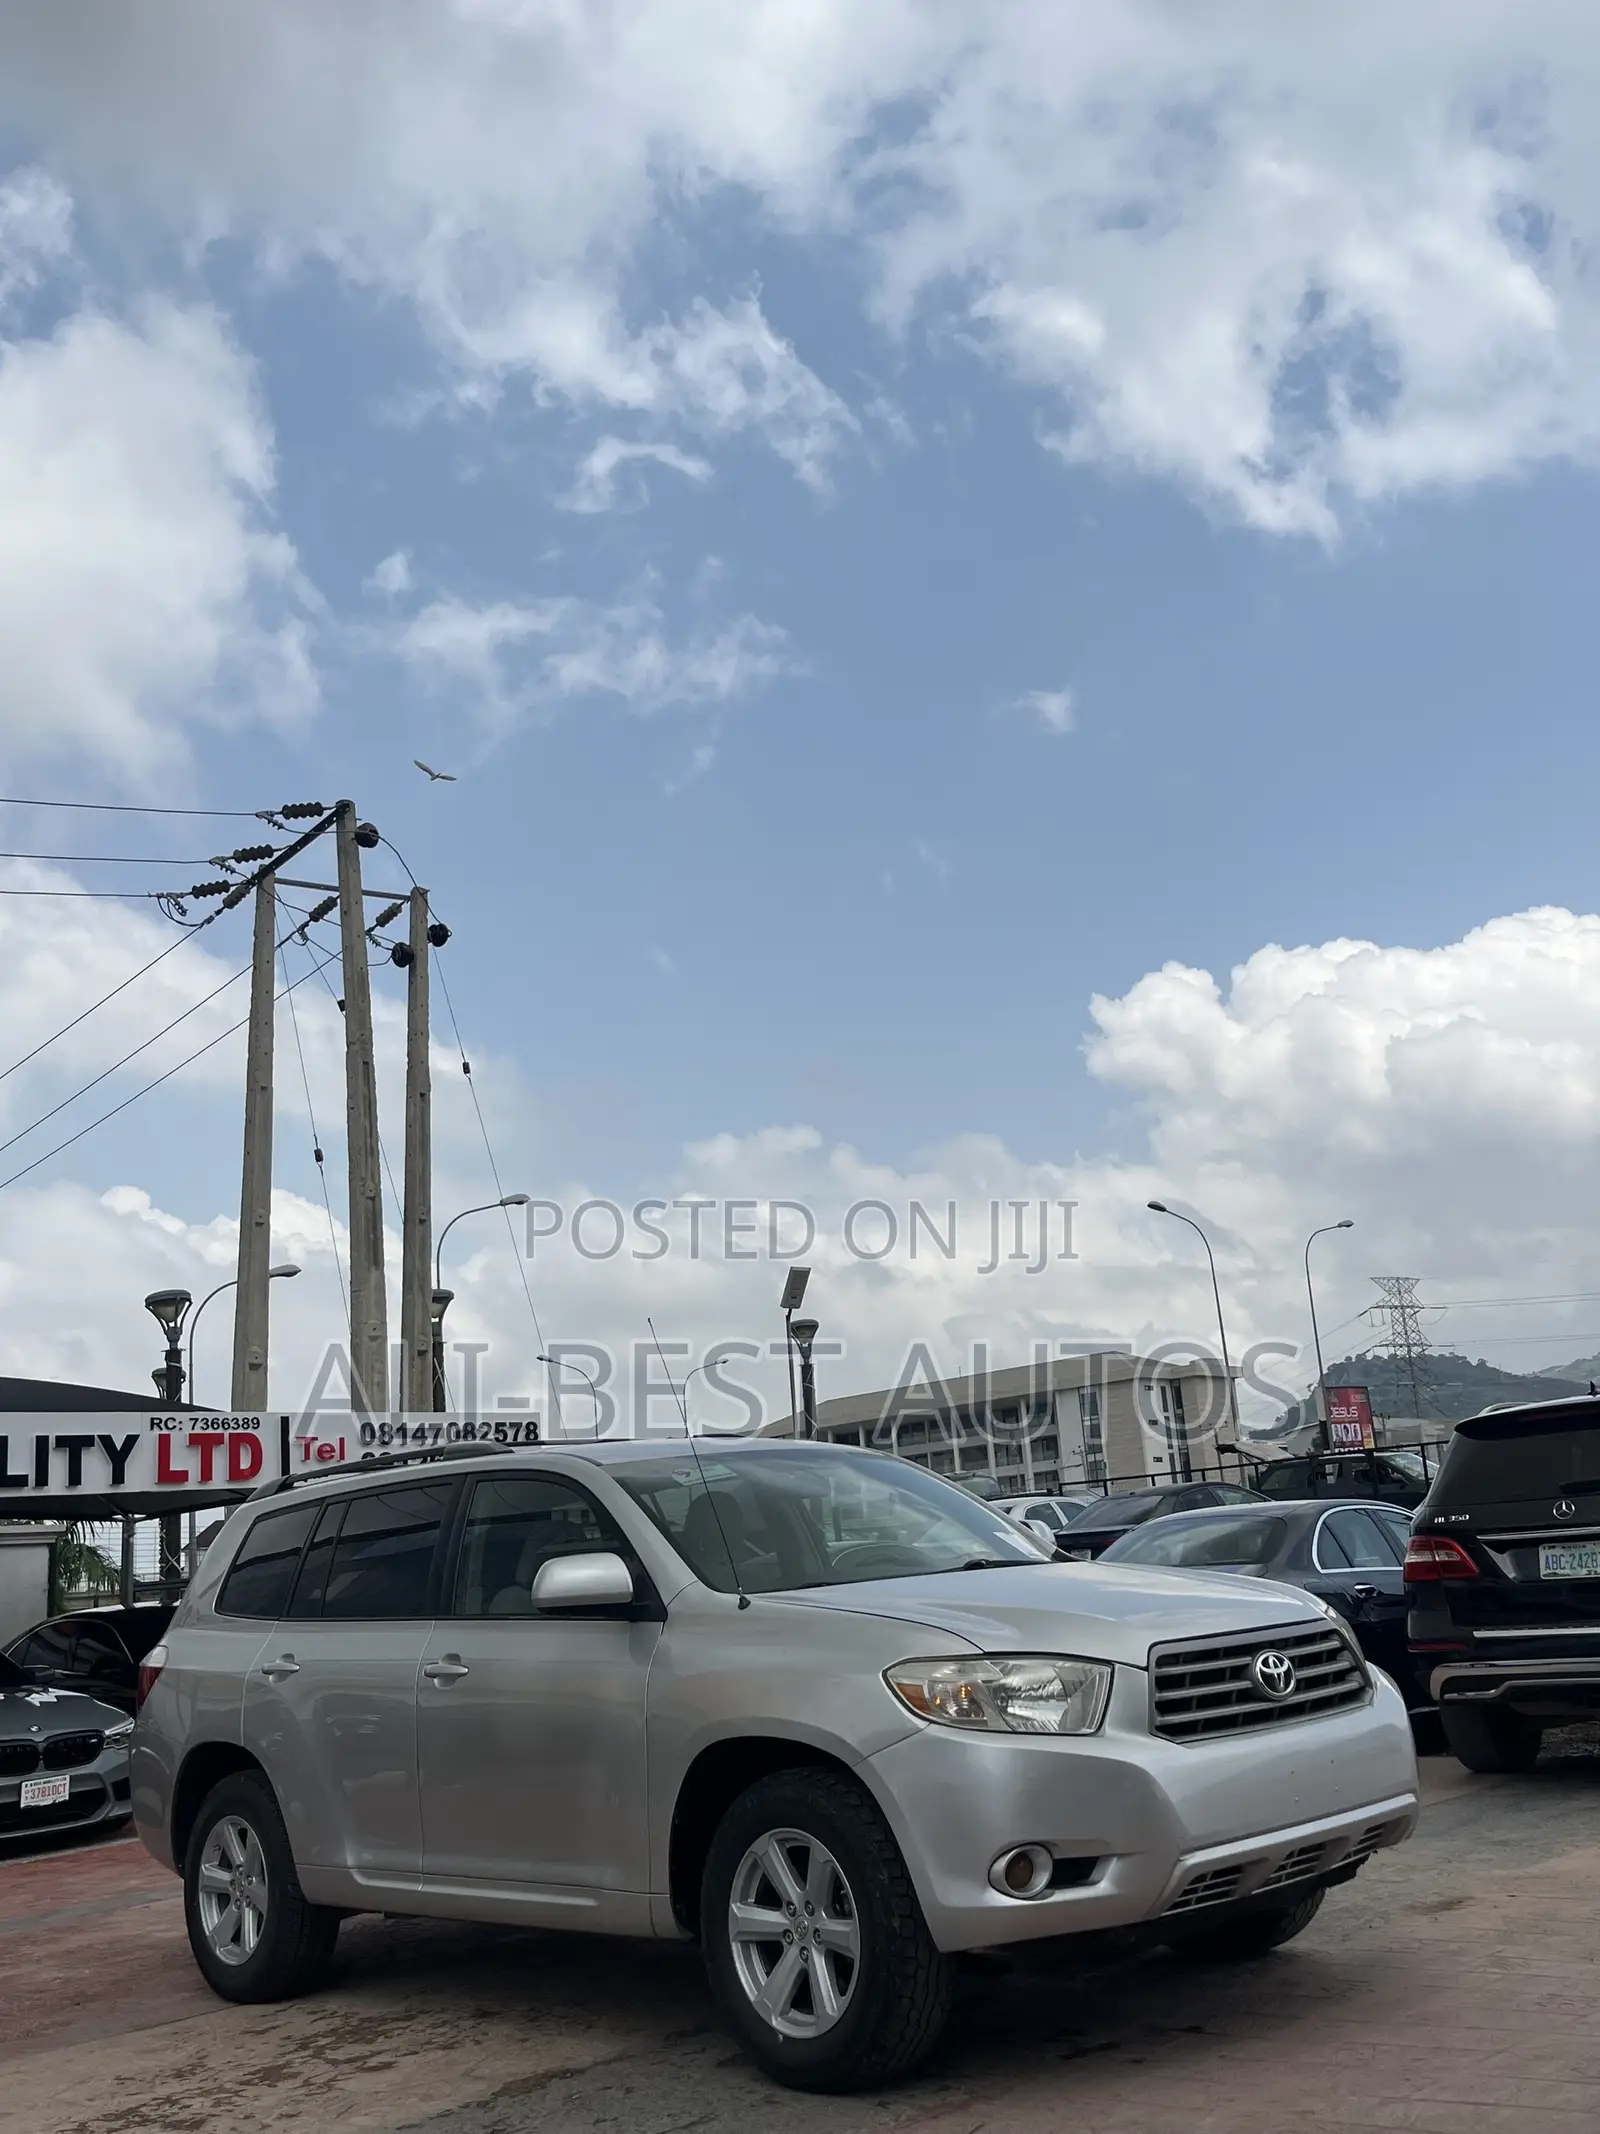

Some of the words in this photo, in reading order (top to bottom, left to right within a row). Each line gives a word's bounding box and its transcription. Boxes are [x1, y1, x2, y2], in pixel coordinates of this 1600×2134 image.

[1330, 1405, 1359, 1418] JESUS
[150, 1416, 183, 1431] RC:
[188, 1416, 261, 1431] 7366389
[295, 1436, 346, 1462] Tel
[360, 1421, 540, 1446] 08147082578
[156, 1431, 264, 1485] LTD
[1544, 1551, 1600, 1571] ABC-242B
